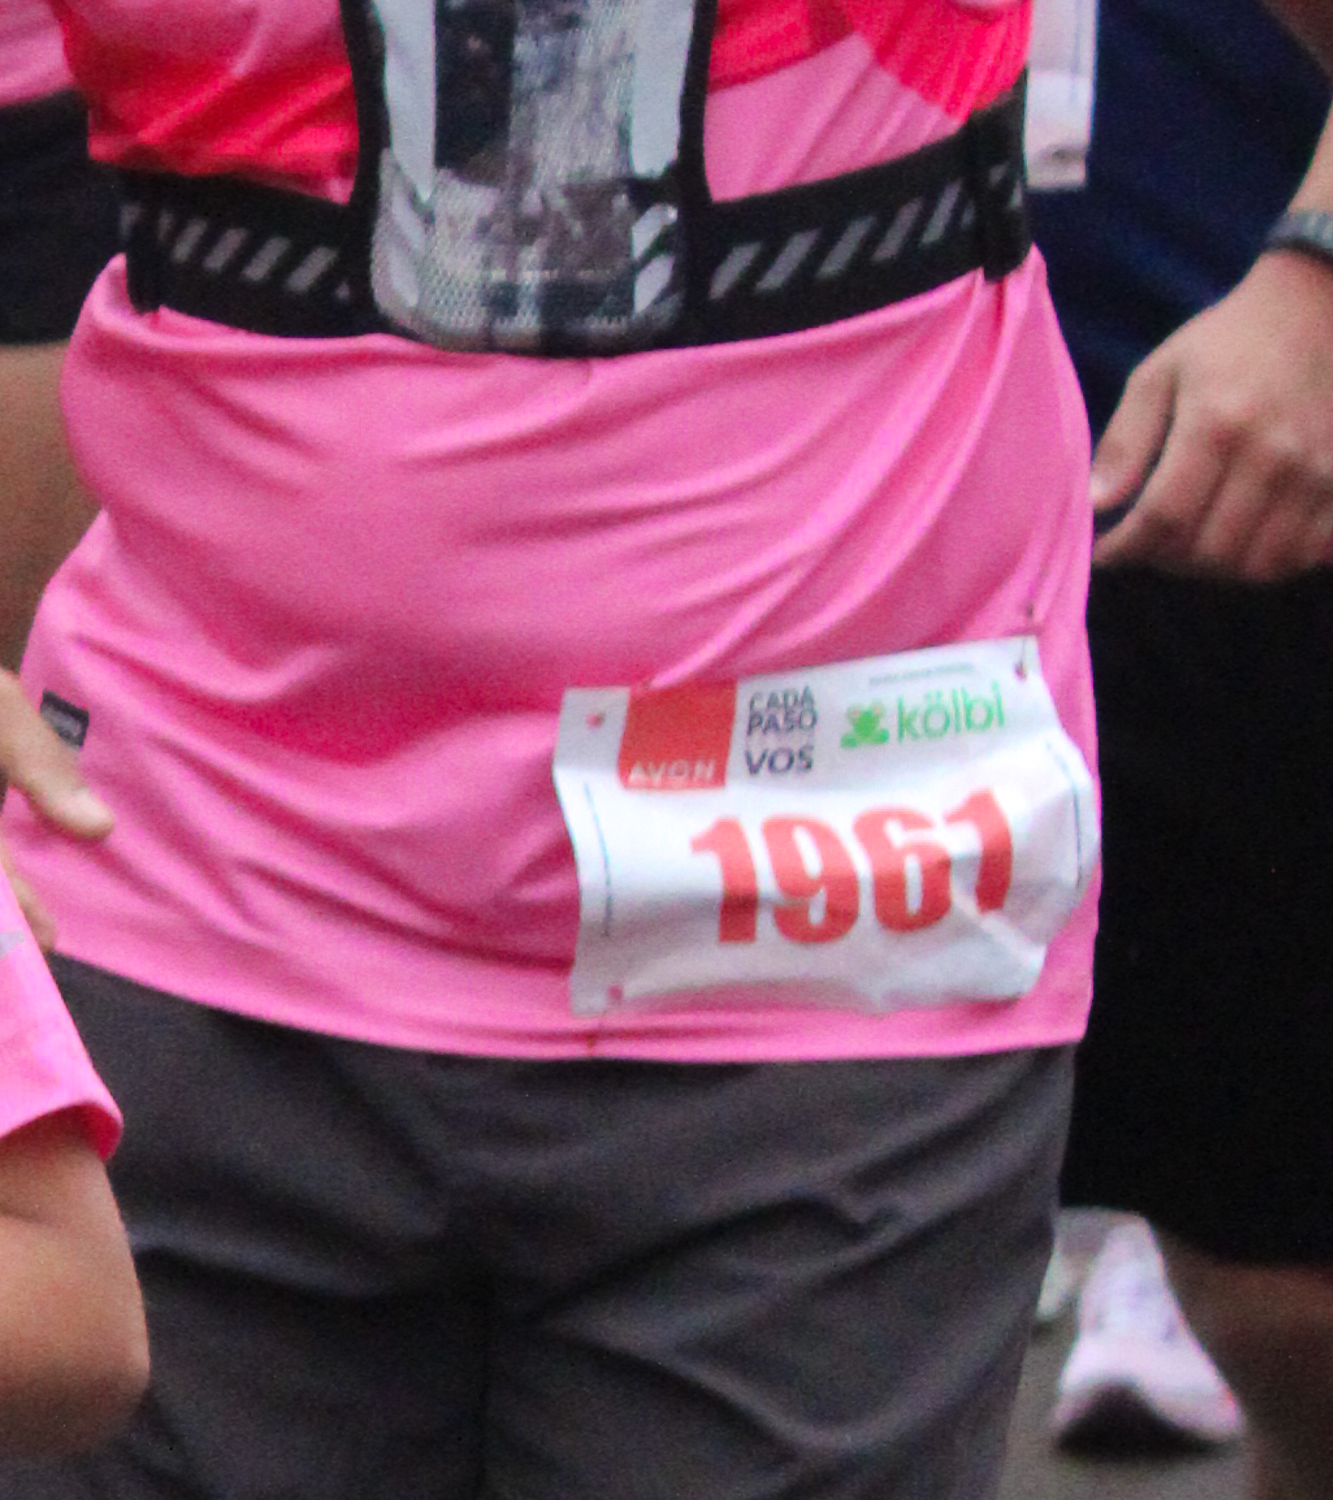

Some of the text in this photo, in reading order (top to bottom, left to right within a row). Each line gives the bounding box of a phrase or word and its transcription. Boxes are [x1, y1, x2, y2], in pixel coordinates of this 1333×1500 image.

[748, 685, 816, 712] CADA
[746, 709, 819, 737] PASO
[627, 759, 717, 788] AVON
[744, 745, 816, 776] VOS
[690, 788, 1014, 944] 1961
